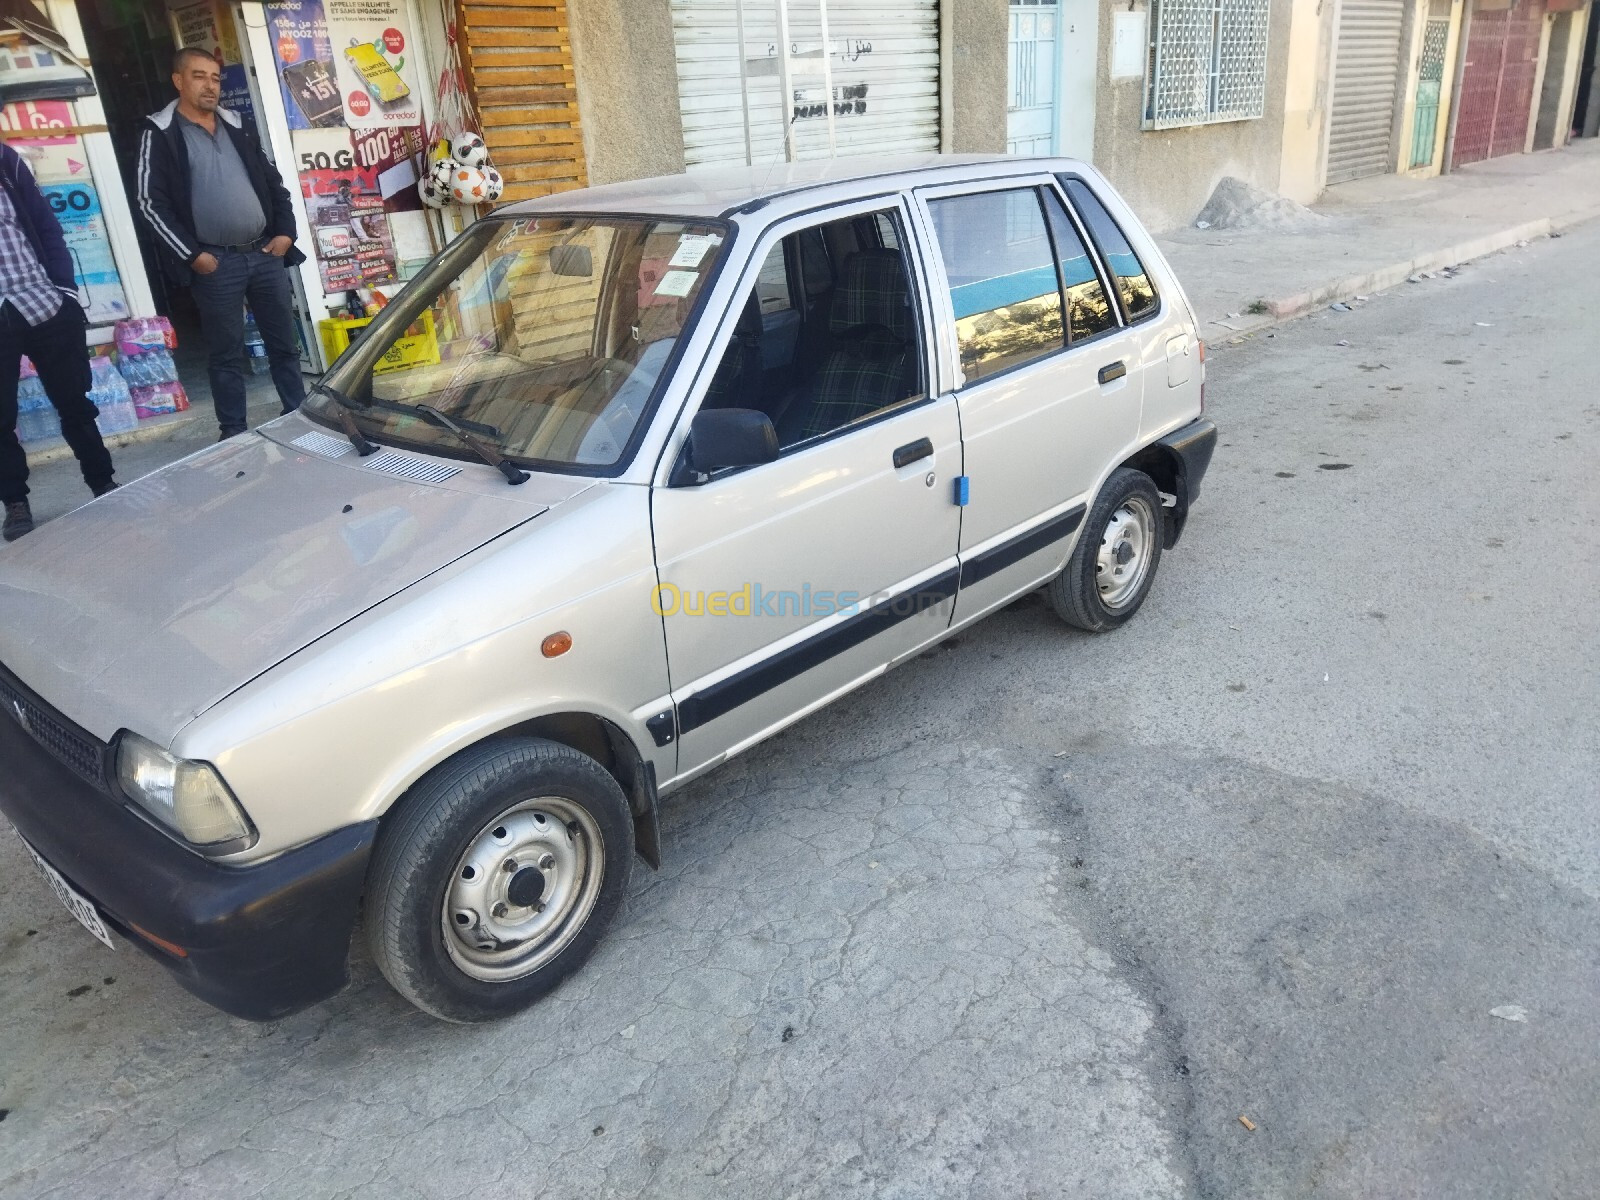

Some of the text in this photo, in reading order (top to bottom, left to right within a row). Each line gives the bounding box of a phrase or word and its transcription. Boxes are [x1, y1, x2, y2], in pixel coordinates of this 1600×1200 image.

[268, 2, 302, 10] ooredoo
[383, 111, 417, 120] ooredoo
[358, 130, 391, 166] 100
[301, 151, 331, 172] 50
[361, 259, 386, 269] APPELS
